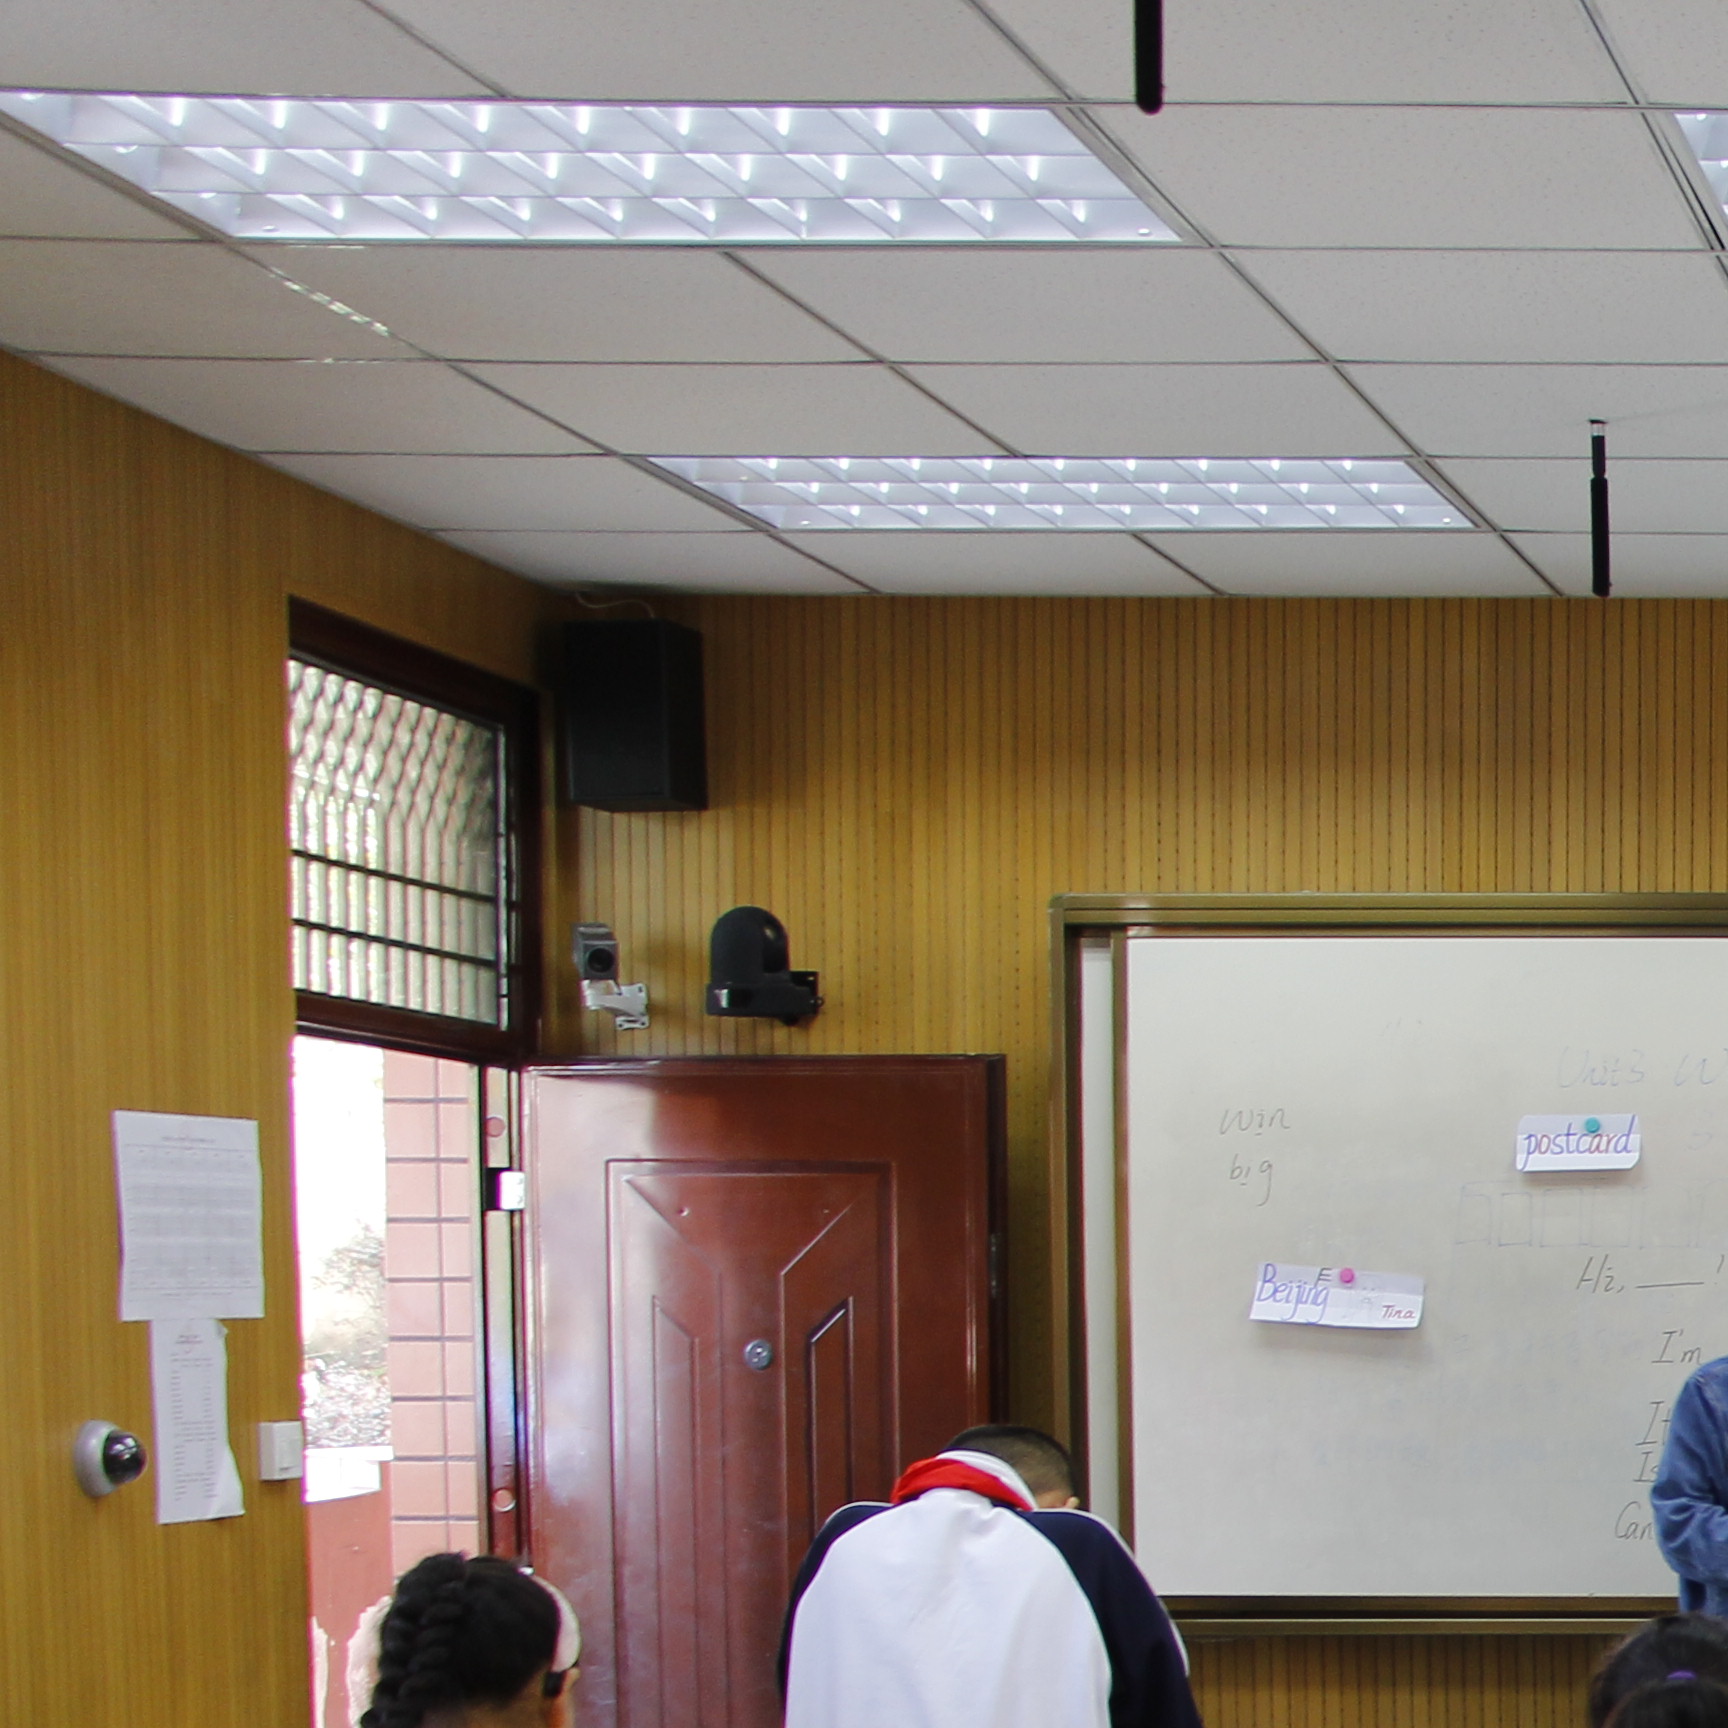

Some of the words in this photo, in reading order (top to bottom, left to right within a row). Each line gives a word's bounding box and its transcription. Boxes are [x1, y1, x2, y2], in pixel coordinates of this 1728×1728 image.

[1520, 1114, 1636, 1171] postcard
[1230, 1153, 1273, 1206] big
[1256, 1263, 1329, 1324] Beijing
[1382, 1305, 1416, 1319] Tina
[1651, 1329, 1700, 1364] I'm
